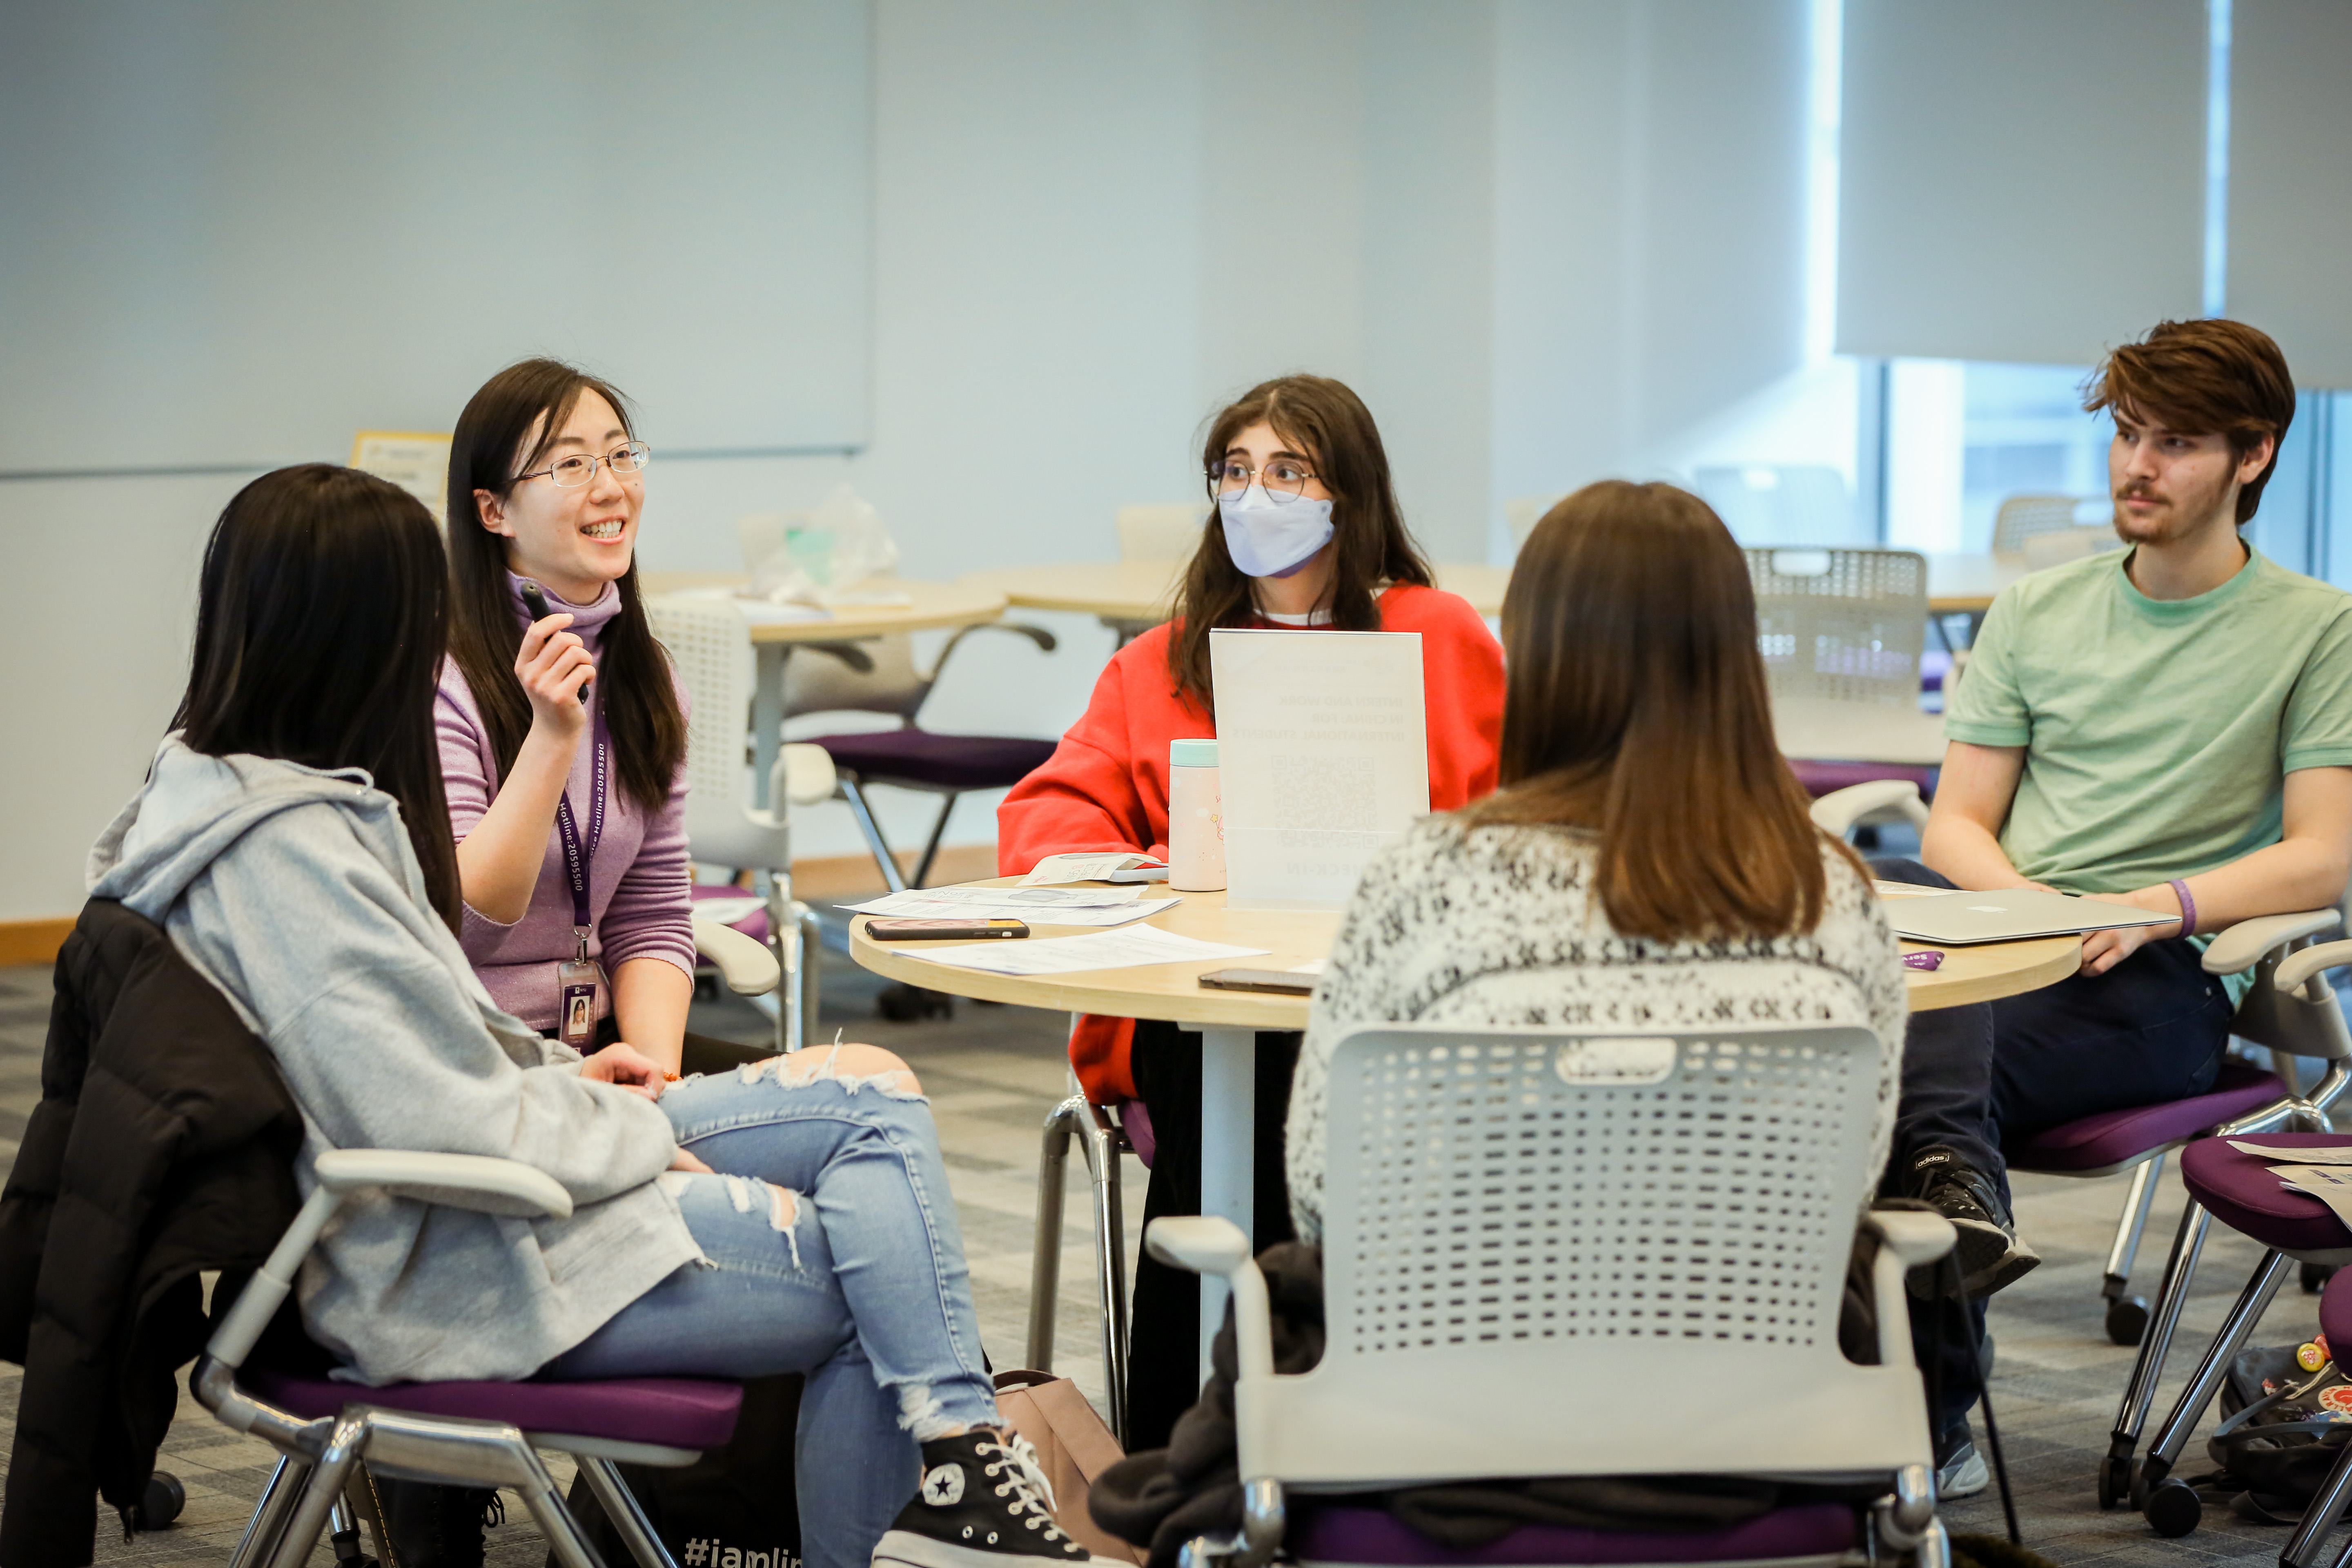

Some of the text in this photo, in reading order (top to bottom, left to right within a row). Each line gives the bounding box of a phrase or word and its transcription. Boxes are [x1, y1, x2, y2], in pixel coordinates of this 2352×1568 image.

[595, 743, 604, 833] Hotline:20595500
[559, 803, 583, 891] Hotline:20595500
[1918, 1156, 1944, 1167] adidas
